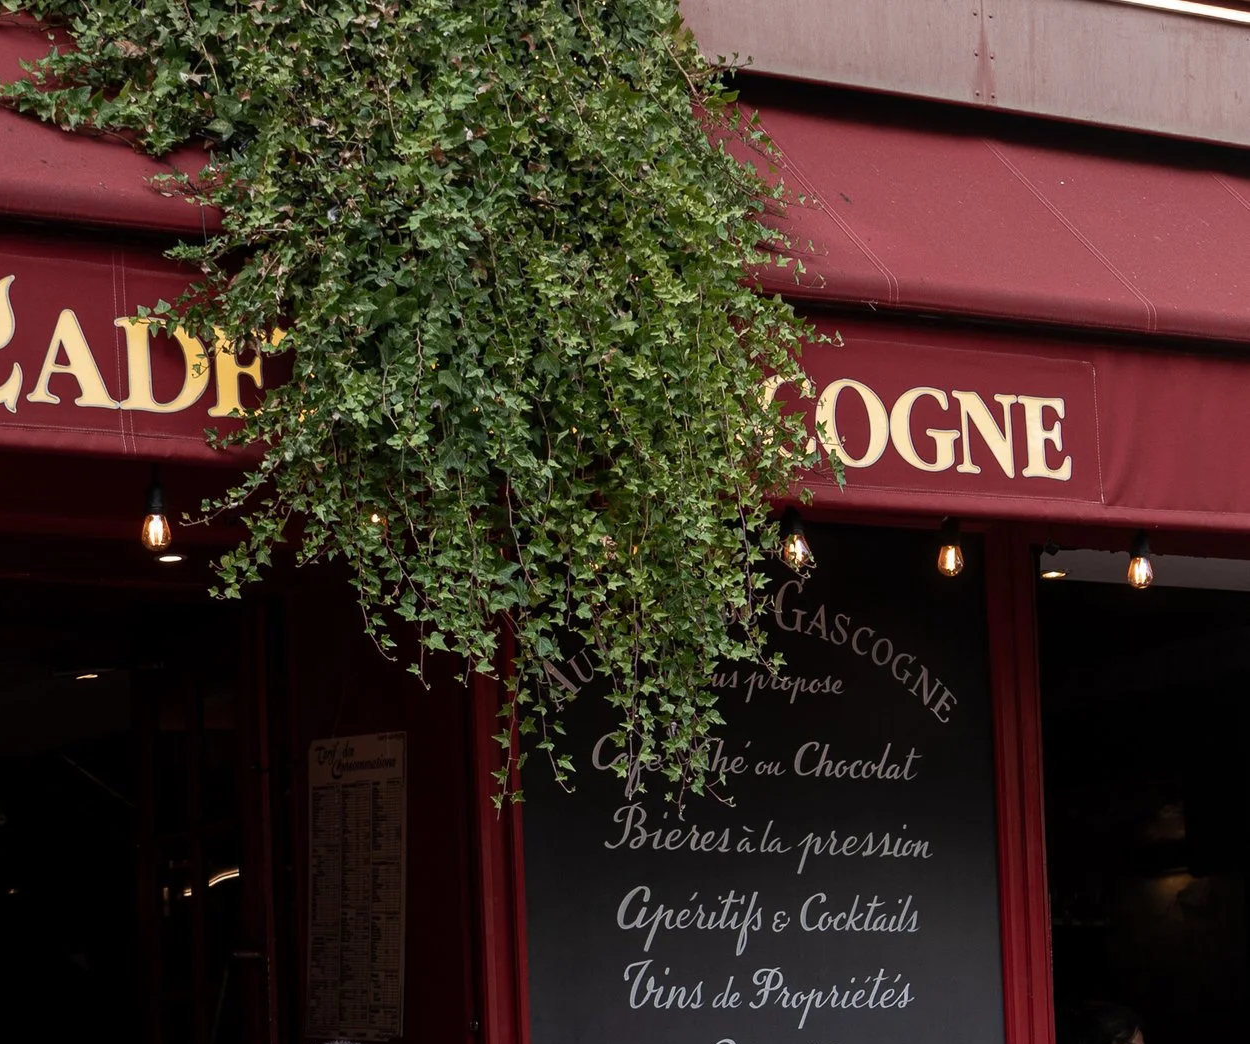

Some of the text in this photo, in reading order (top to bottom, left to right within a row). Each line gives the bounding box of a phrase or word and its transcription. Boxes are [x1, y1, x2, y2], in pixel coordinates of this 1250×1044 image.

[744, 671, 846, 704] propose
[754, 760, 786, 777] ou
[794, 741, 923, 781] Chocolat
[604, 802, 933, 875] Bières à la pression
[616, 886, 921, 956] Apéritifs & Cocktails
[623, 959, 916, 1029] Vins de Propriétés
